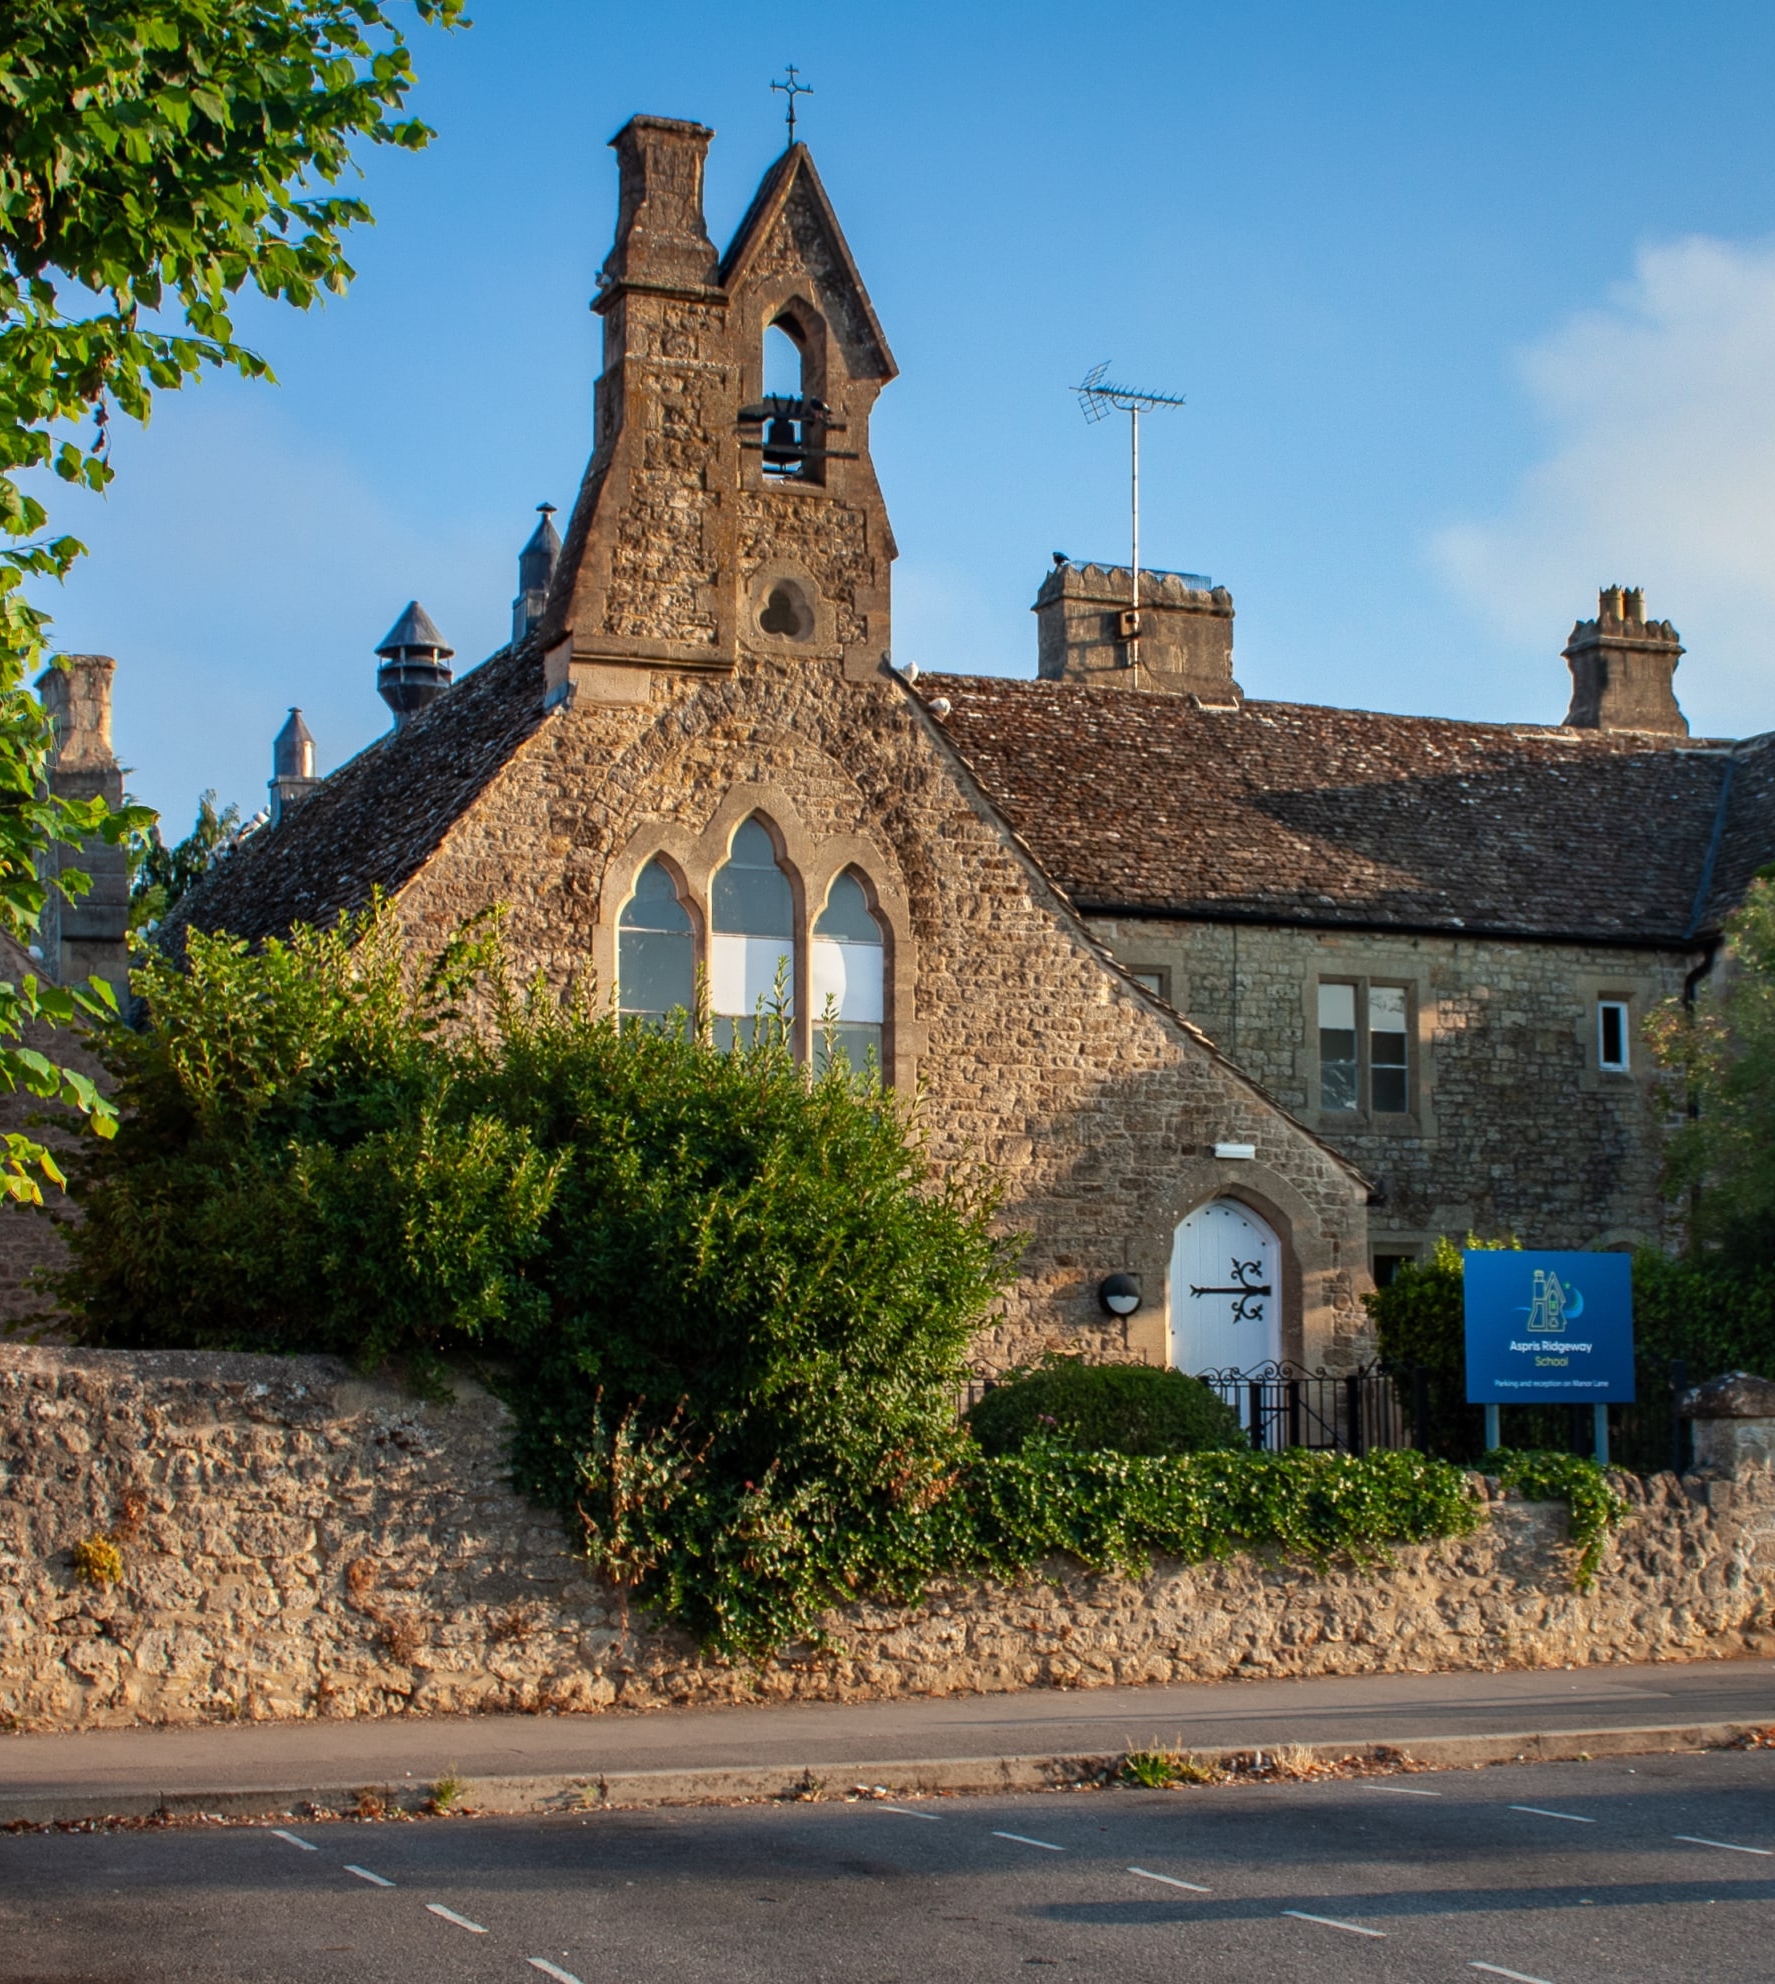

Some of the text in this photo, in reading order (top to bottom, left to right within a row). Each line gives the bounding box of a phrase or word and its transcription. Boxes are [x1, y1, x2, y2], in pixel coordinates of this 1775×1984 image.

[1509, 1341, 1592, 1354] Aspris Ridgeway
[1534, 1356, 1569, 1367] School
[1494, 1379, 1518, 1388] Parking
[1519, 1379, 1532, 1387] and
